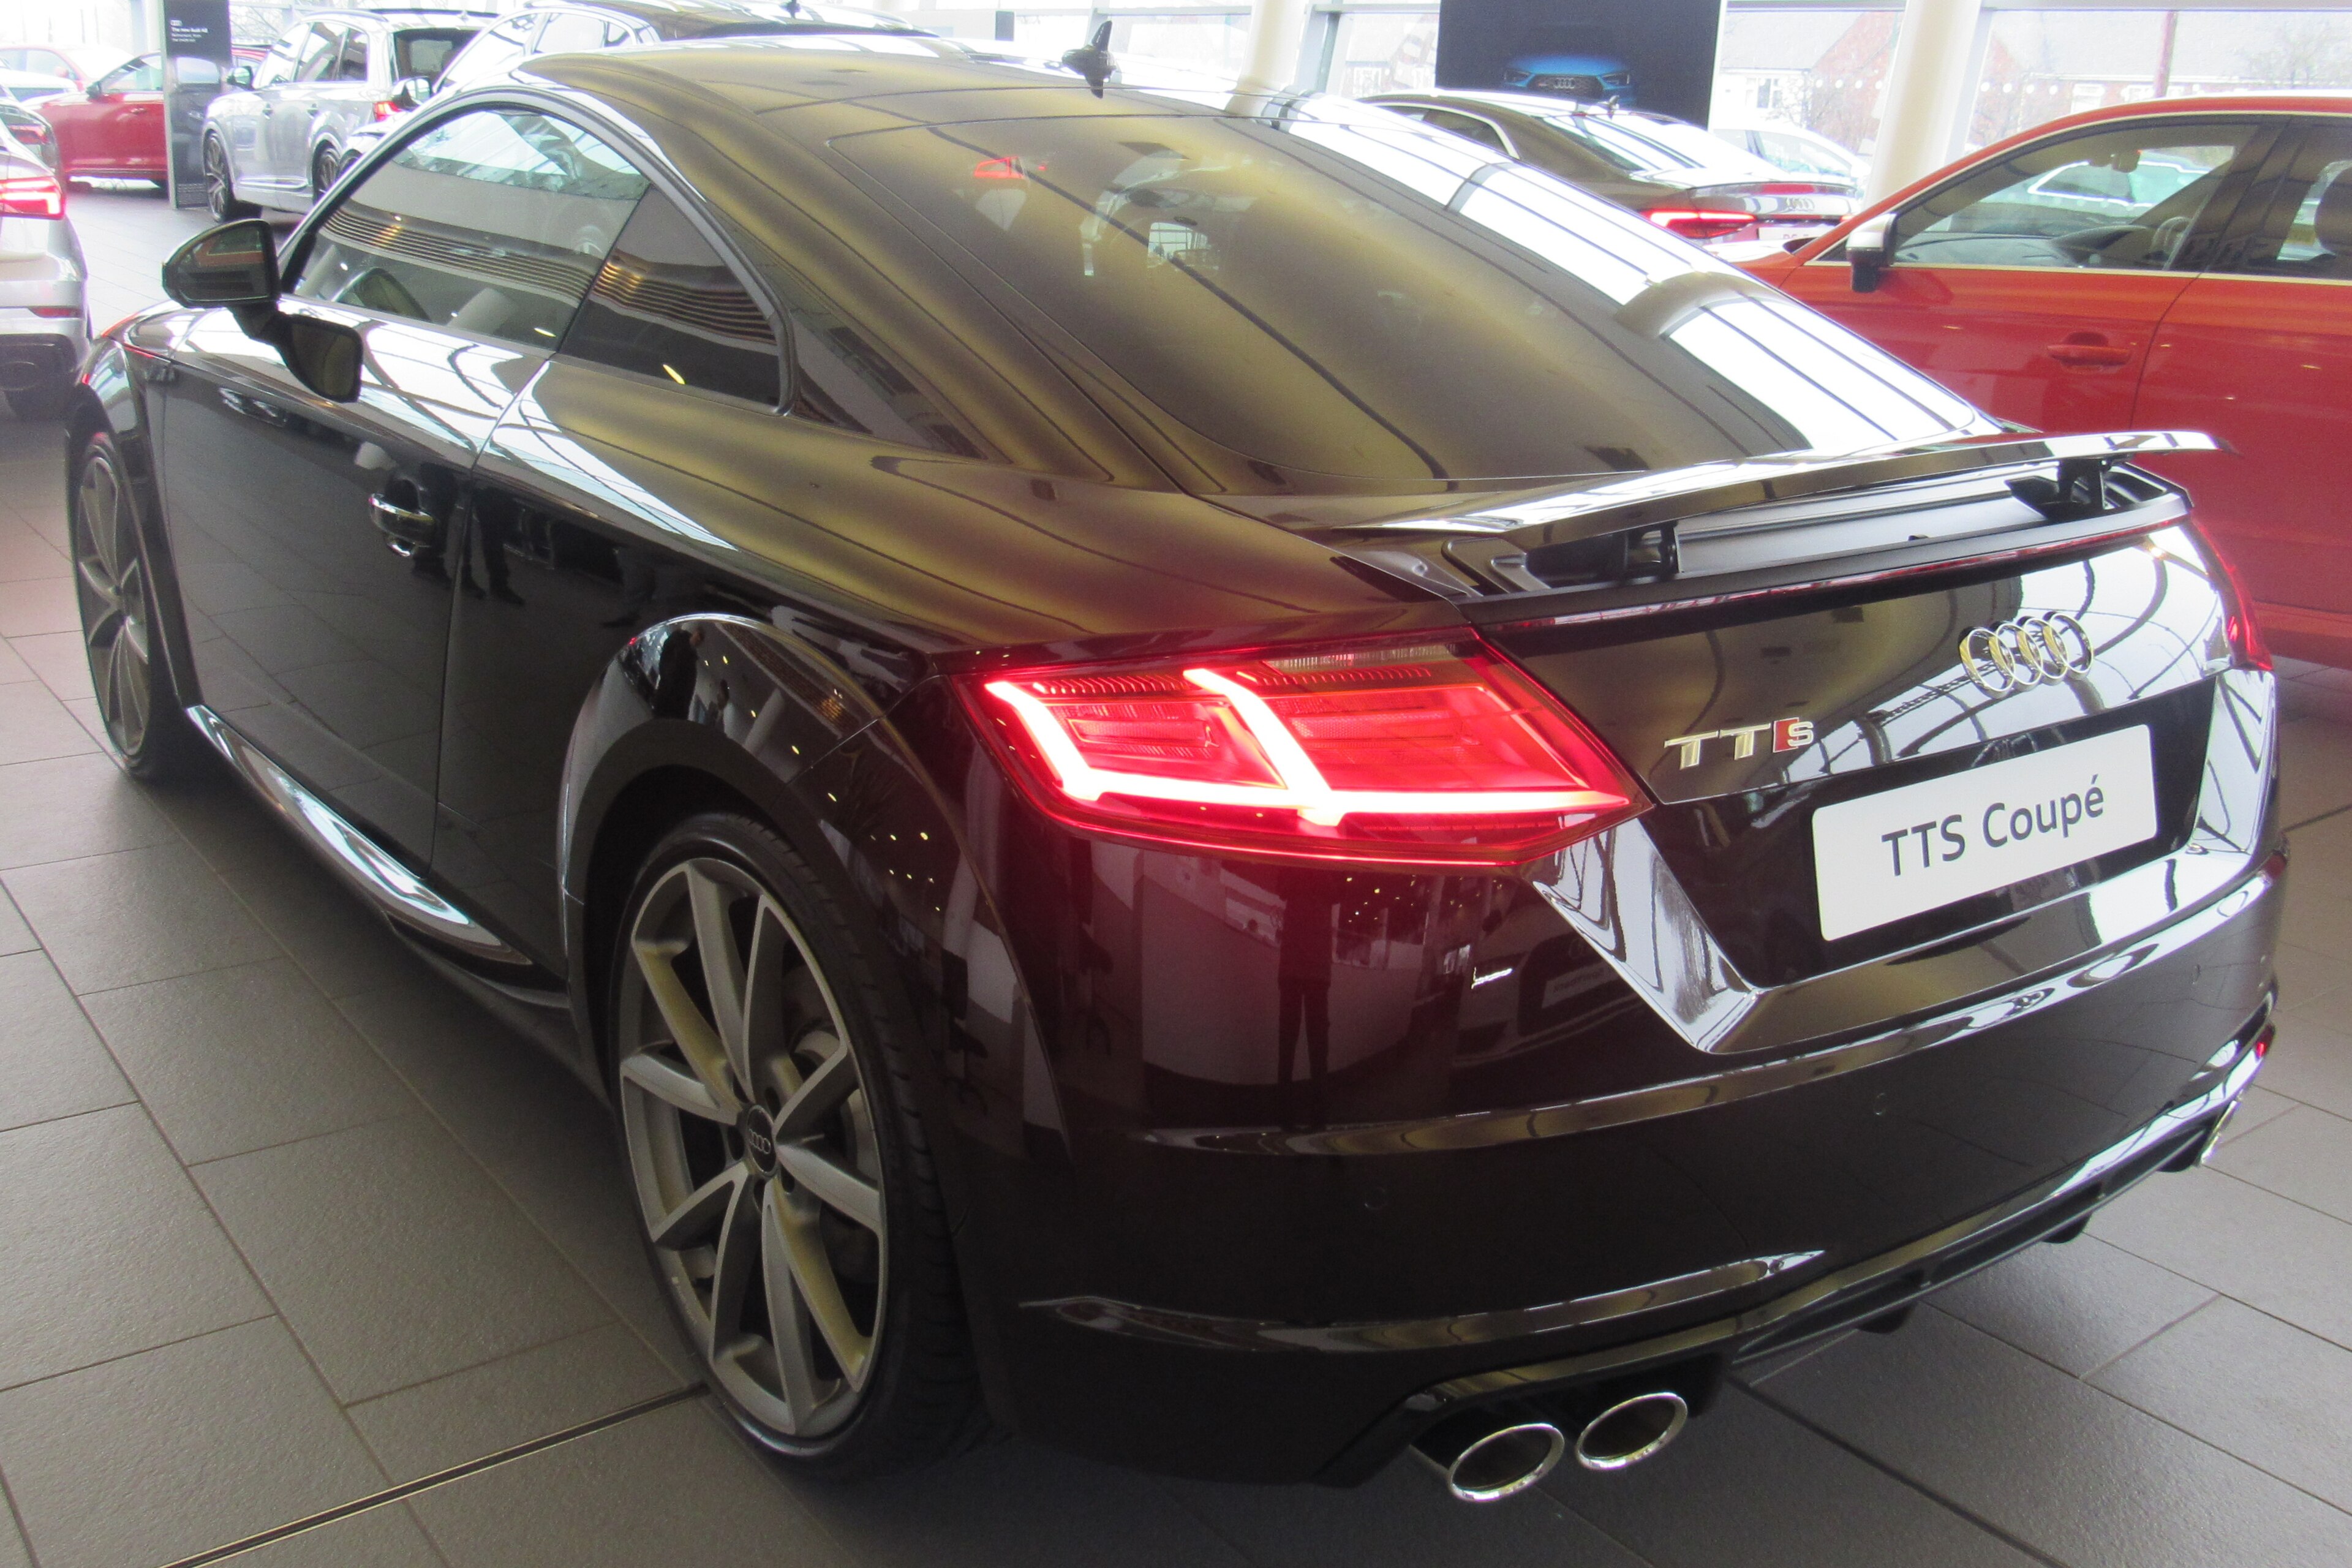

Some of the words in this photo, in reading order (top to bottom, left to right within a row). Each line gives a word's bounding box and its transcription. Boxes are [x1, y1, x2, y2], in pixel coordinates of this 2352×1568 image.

[1664, 717, 1814, 770] TTS
[1881, 814, 1966, 876] TTS
[1982, 774, 2104, 848] Coupé
